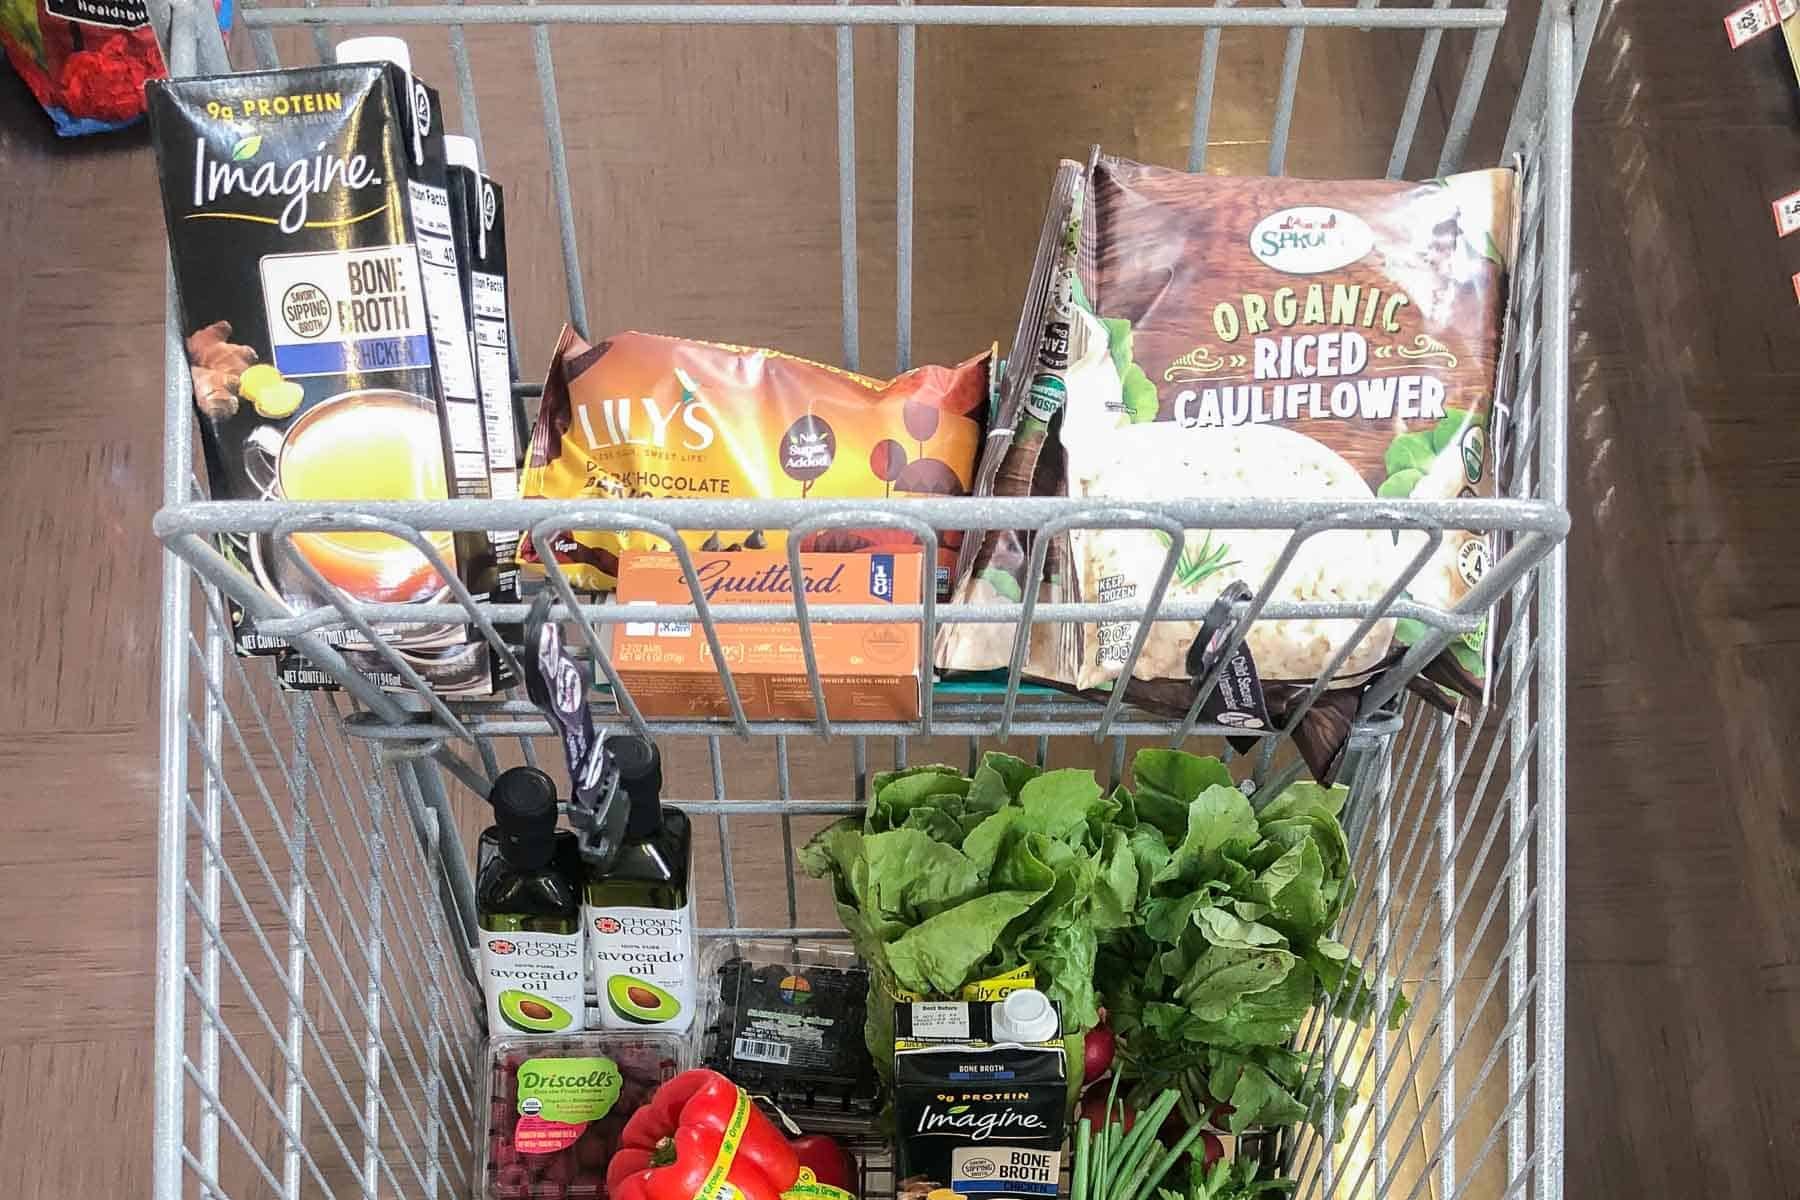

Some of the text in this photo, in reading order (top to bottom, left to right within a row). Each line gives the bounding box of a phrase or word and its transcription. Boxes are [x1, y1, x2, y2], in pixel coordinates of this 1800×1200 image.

[243, 93, 342, 117] PROTEIN
[426, 189, 447, 207] Facts
[1260, 230, 1331, 257] SPRO
[444, 248, 455, 263] 40
[287, 300, 328, 322] SIPPING
[1212, 283, 1410, 343] ORGANIC
[298, 320, 323, 334] BROTH
[1253, 333, 1368, 381] RICED
[1173, 376, 1448, 429] CAULIFLOWER
[633, 471, 731, 494] HOCOLATE
[1474, 555, 1482, 577] 4
[1098, 574, 1125, 592] KEEP
[1098, 584, 1137, 604] FROZEN
[241, 634, 291, 649] NET CONTEN
[1232, 656, 1249, 677] Child
[284, 670, 297, 684] NET
[622, 917, 682, 927] CHOSEN
[622, 926, 682, 937] FOODS
[515, 941, 577, 950] CHOSEN
[517, 949, 577, 958] FOODS
[597, 951, 684, 963] avocado
[490, 968, 578, 982] avocado
[629, 963, 655, 976] oil
[522, 980, 548, 992] oil
[959, 1065, 979, 1073] BONE
[522, 1071, 617, 1089] Driscoll's
[962, 1091, 1030, 1102] PROTEIN
[1011, 1152, 1050, 1168] BONE
[999, 1165, 1049, 1182] BROTH
